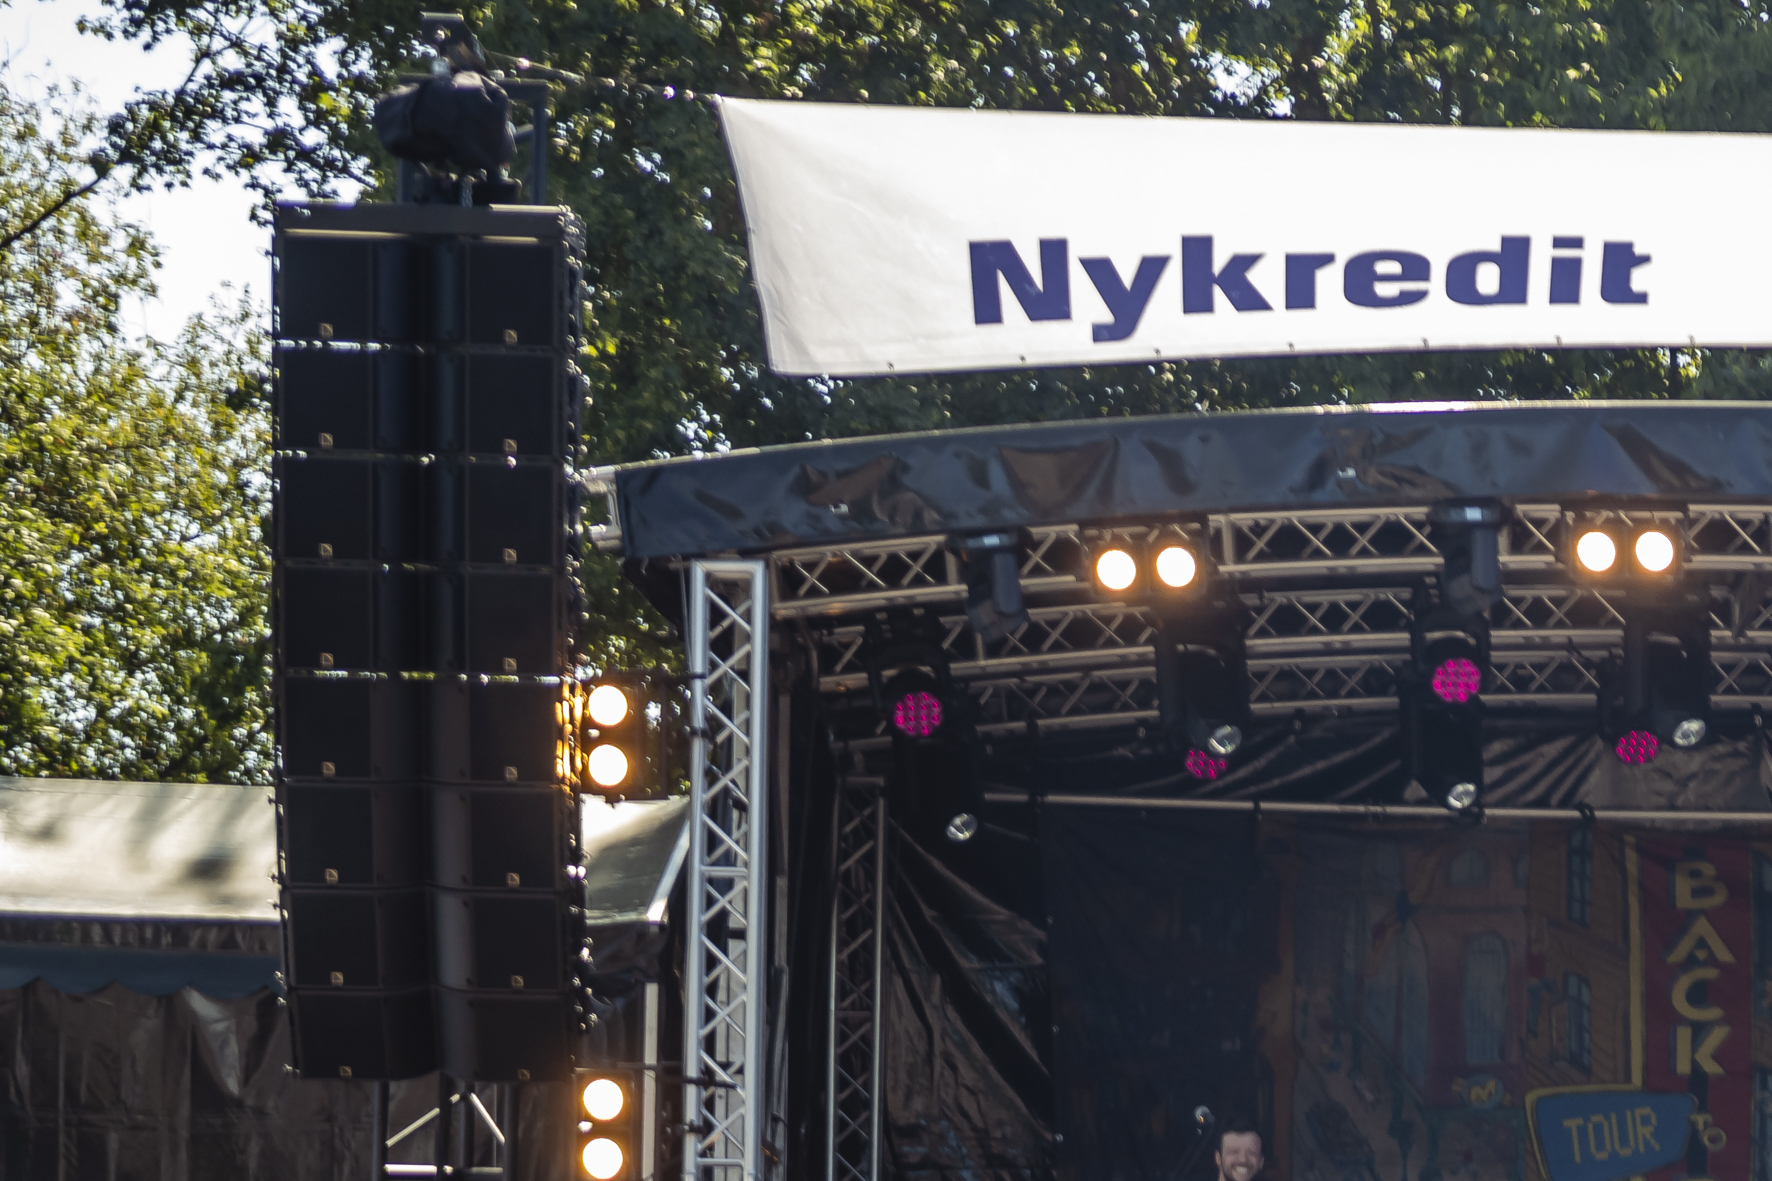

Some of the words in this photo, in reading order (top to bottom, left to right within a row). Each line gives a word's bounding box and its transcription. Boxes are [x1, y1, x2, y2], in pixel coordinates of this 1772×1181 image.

[968, 234, 1652, 343] Nykredit
[1667, 861, 1737, 1076] BACK
[1562, 1106, 1662, 1164] TOUR
[1689, 1113, 1727, 1151] TO
